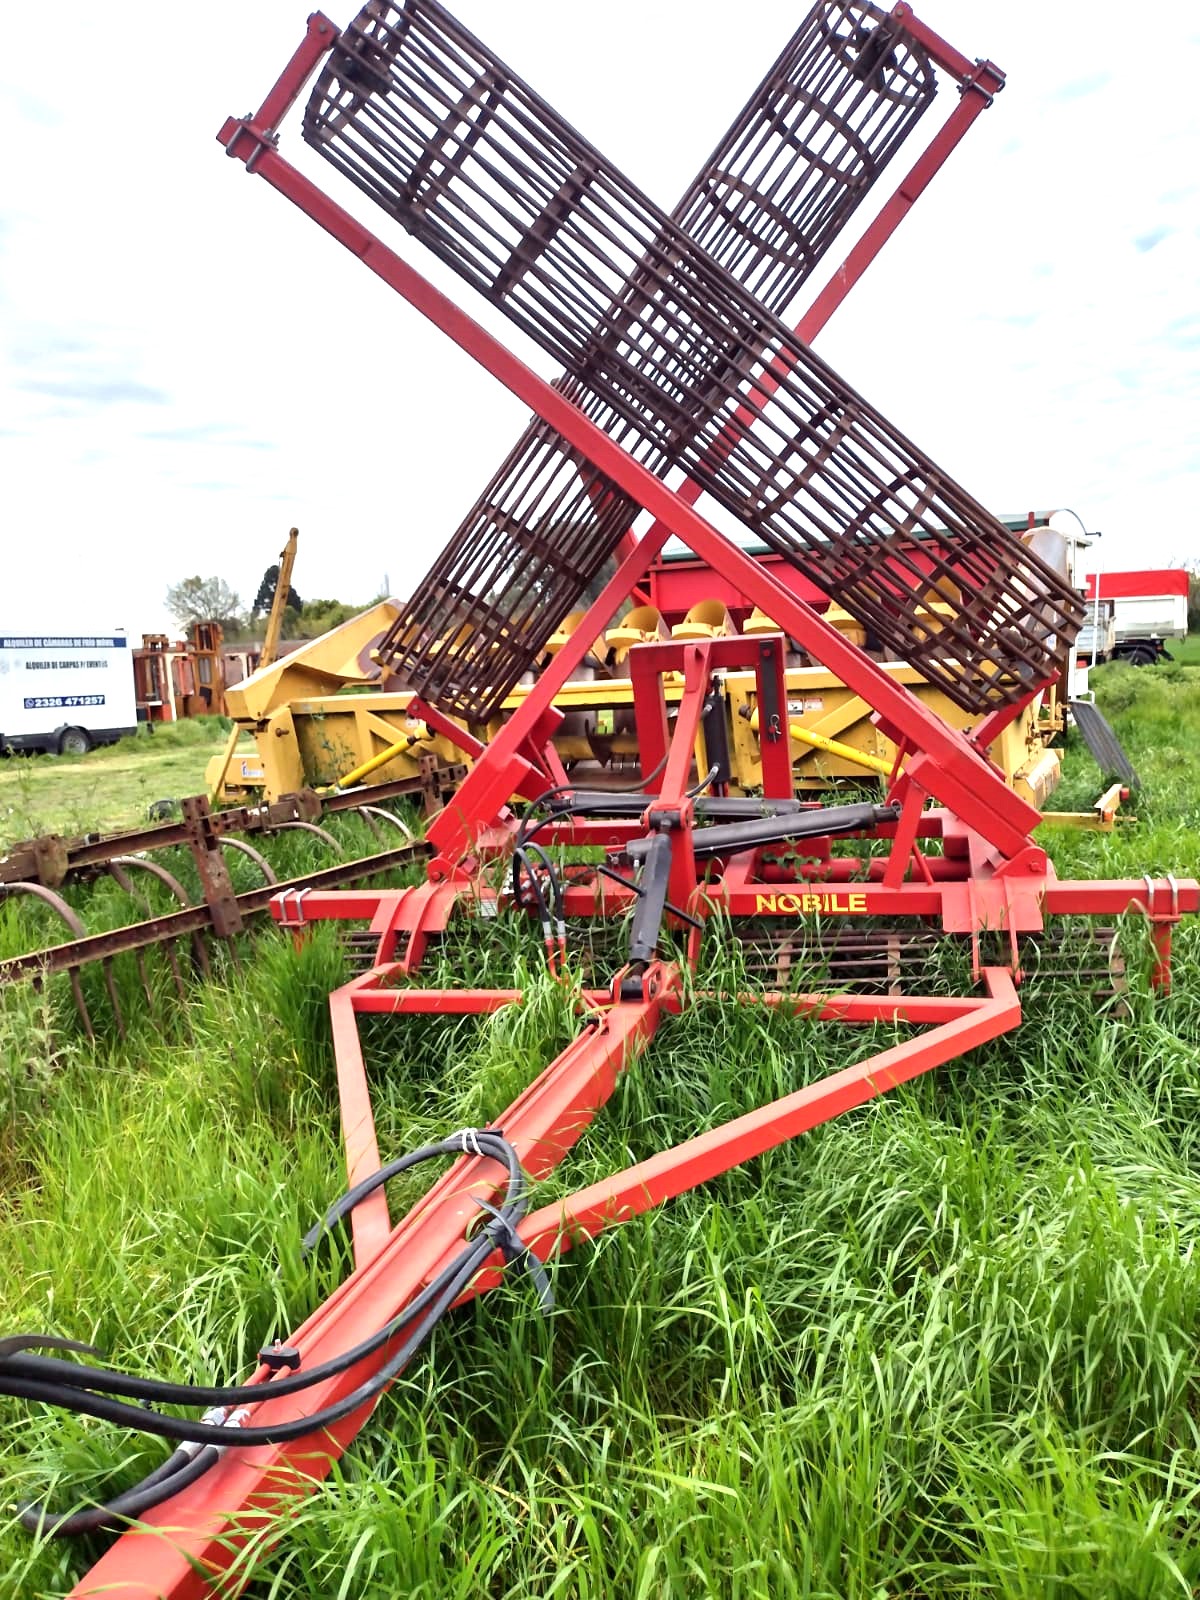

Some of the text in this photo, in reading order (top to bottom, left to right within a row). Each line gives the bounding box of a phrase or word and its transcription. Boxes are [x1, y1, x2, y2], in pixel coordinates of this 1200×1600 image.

[26, 661, 50, 670] ALQUILER
[51, 661, 58, 669] DE
[59, 661, 79, 669] CARPAS
[65, 696, 104, 706] 471257
[755, 893, 868, 913] NOBILE
